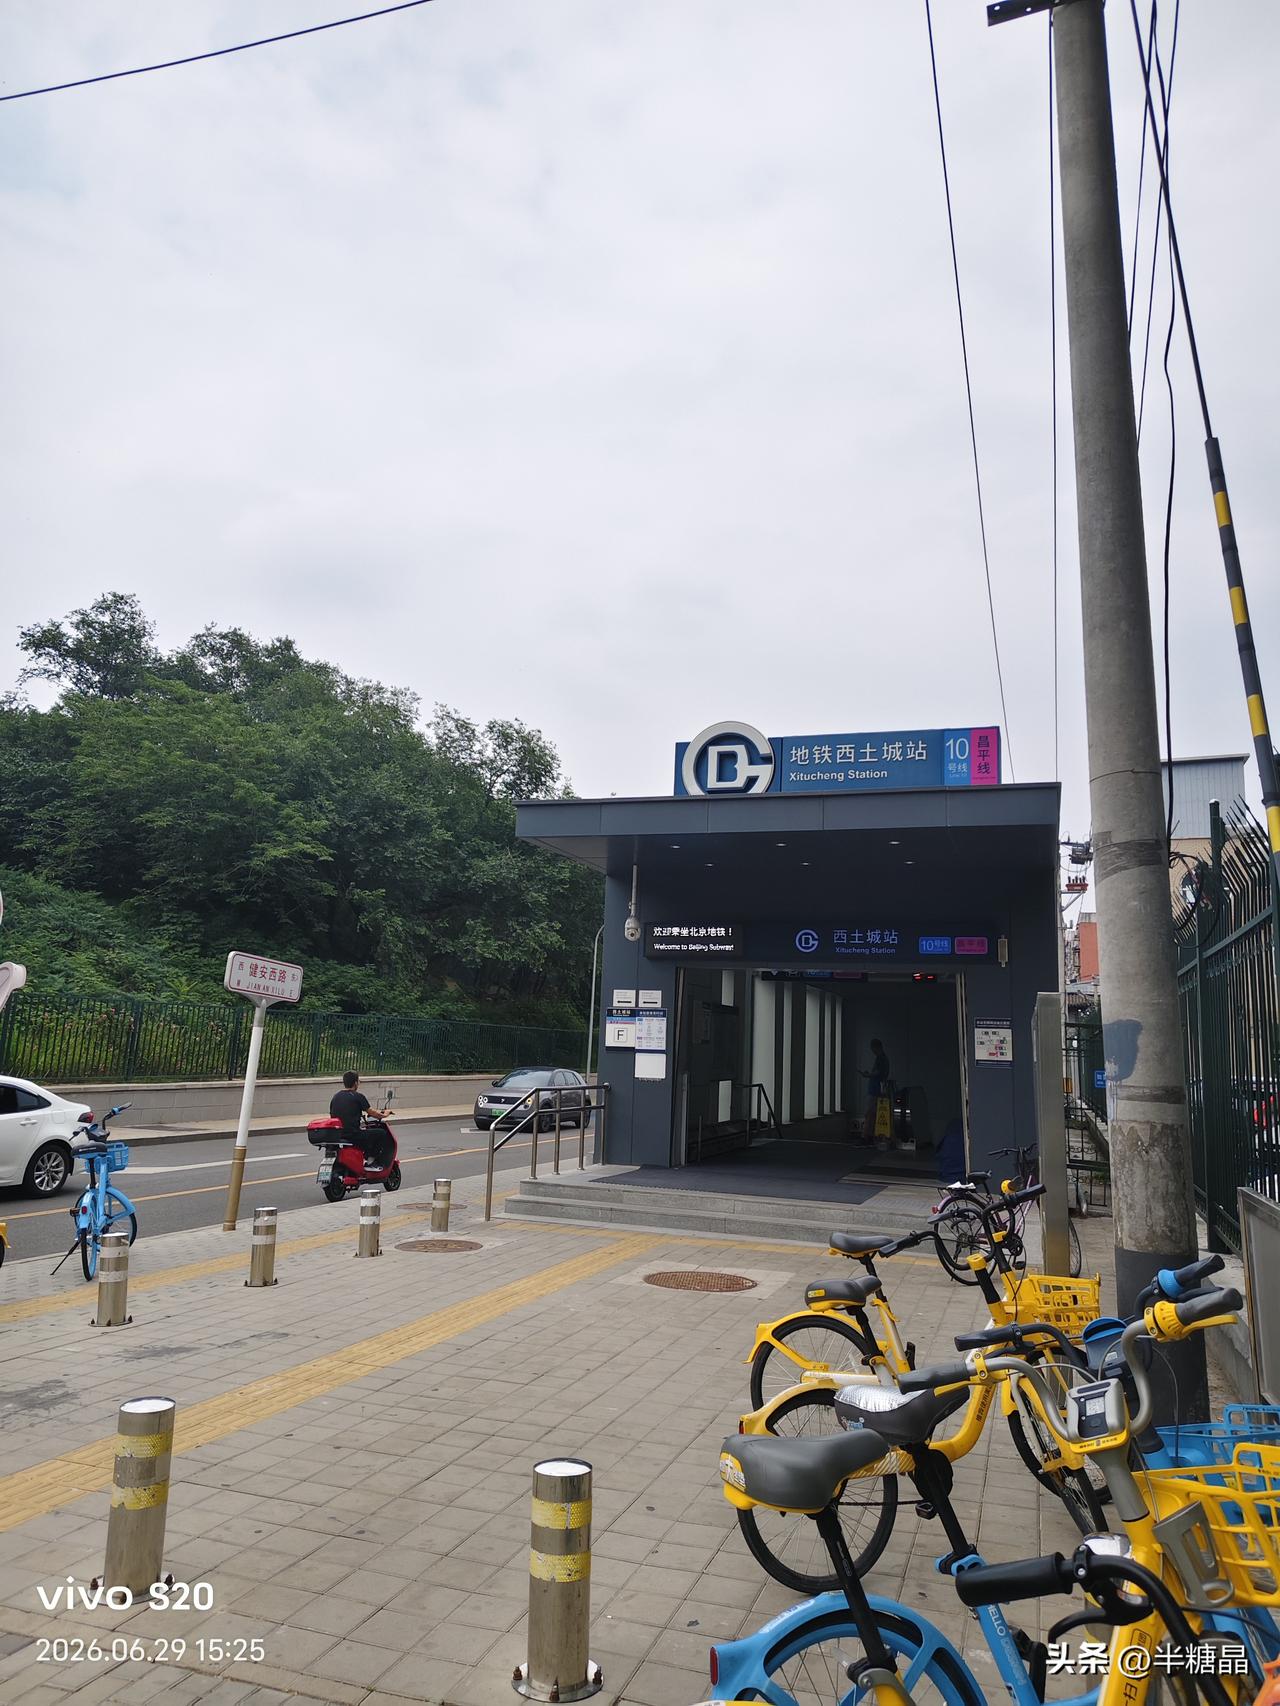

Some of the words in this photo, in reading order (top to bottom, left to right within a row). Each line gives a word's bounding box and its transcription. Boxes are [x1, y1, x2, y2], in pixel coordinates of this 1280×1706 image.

[789, 740, 928, 765] 地铁西土城站
[945, 738, 969, 760] 10
[977, 735, 991, 775] 昌平线
[789, 771, 845, 782] Xitucheng
[847, 769, 888, 780] Station
[948, 763, 968, 774] 号线
[833, 929, 899, 944] 西土城站
[688, 943, 708, 952] Beijing
[835, 947, 870, 955] Xitucheng
[249, 962, 287, 984] 健安西路
[617, 1029, 625, 1041] F
